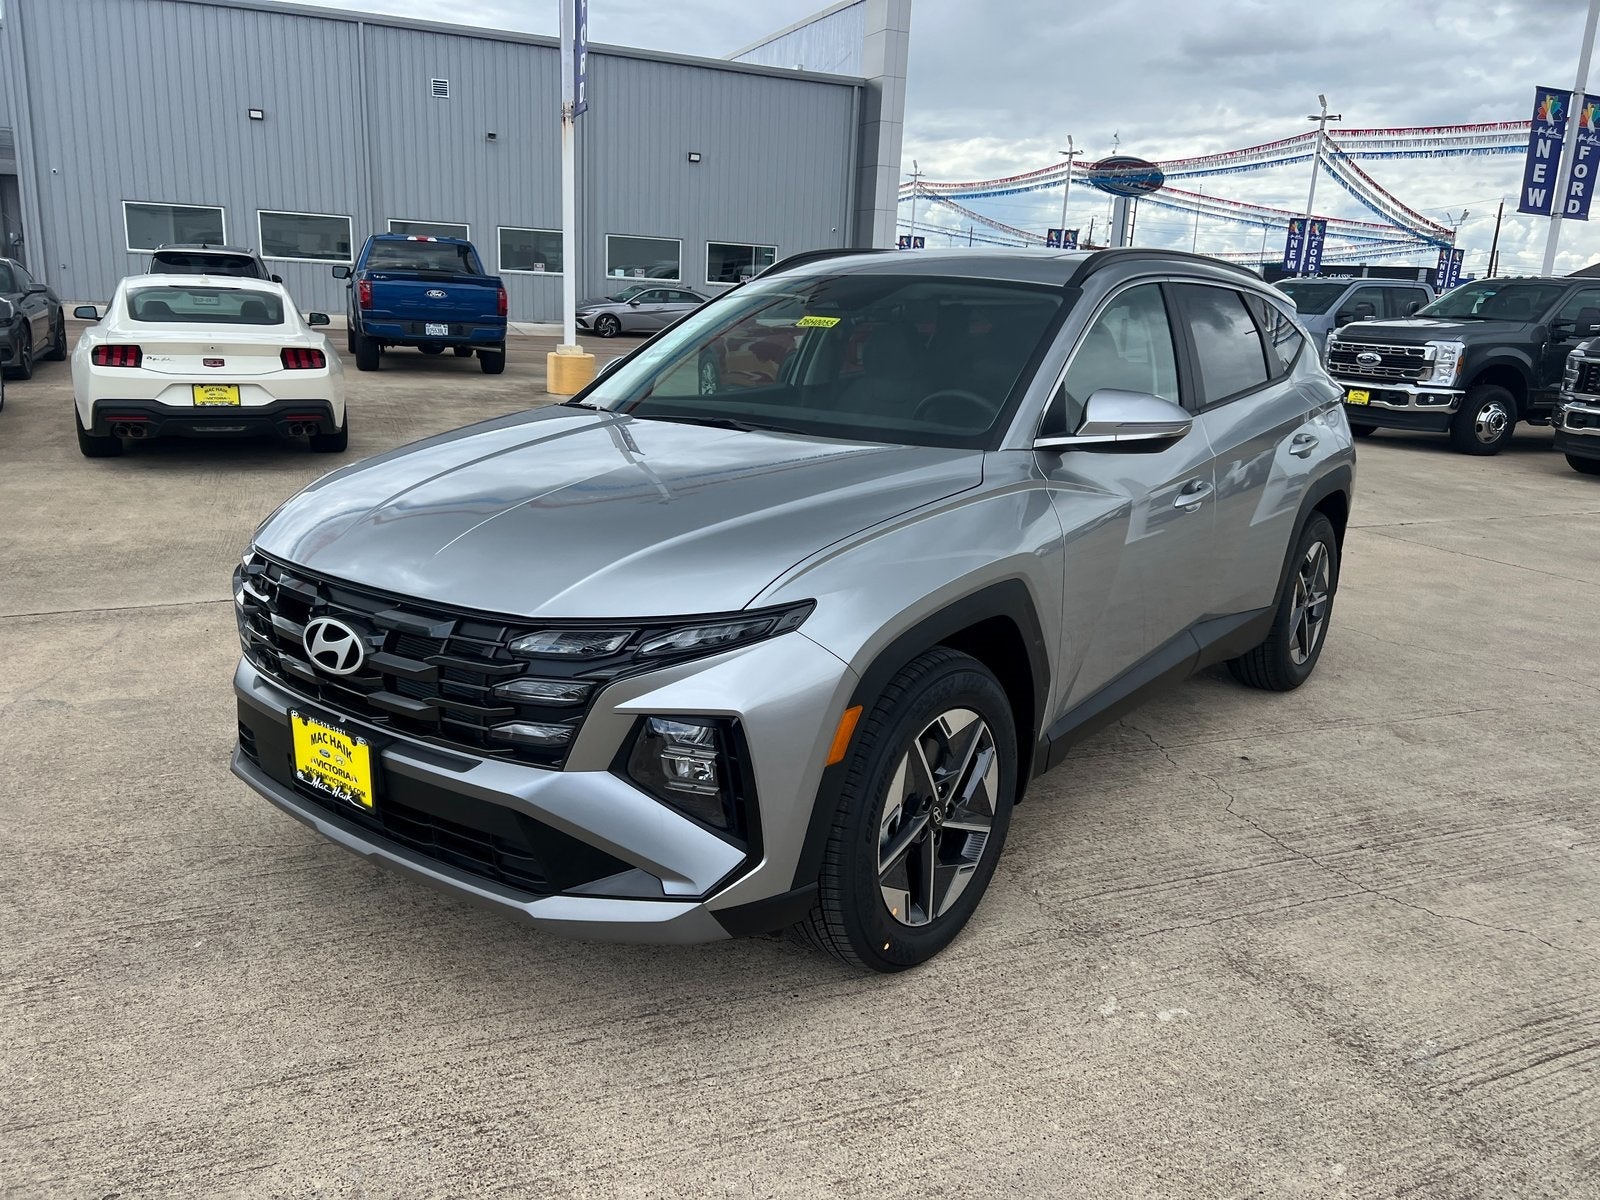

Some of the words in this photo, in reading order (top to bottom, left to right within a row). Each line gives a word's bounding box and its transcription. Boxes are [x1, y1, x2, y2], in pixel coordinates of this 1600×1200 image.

[1528, 138, 1552, 208] NEW
[1567, 145, 1592, 214] FORD
[1286, 239, 1298, 269] NEW
[1308, 241, 1318, 271] FORD
[1436, 263, 1445, 286] NEW
[1450, 264, 1458, 288] FORD
[310, 731, 329, 746] MAC
[329, 734, 353, 762] HAIK
[316, 758, 351, 781] VICTORIA
[309, 776, 331, 794] Mac
